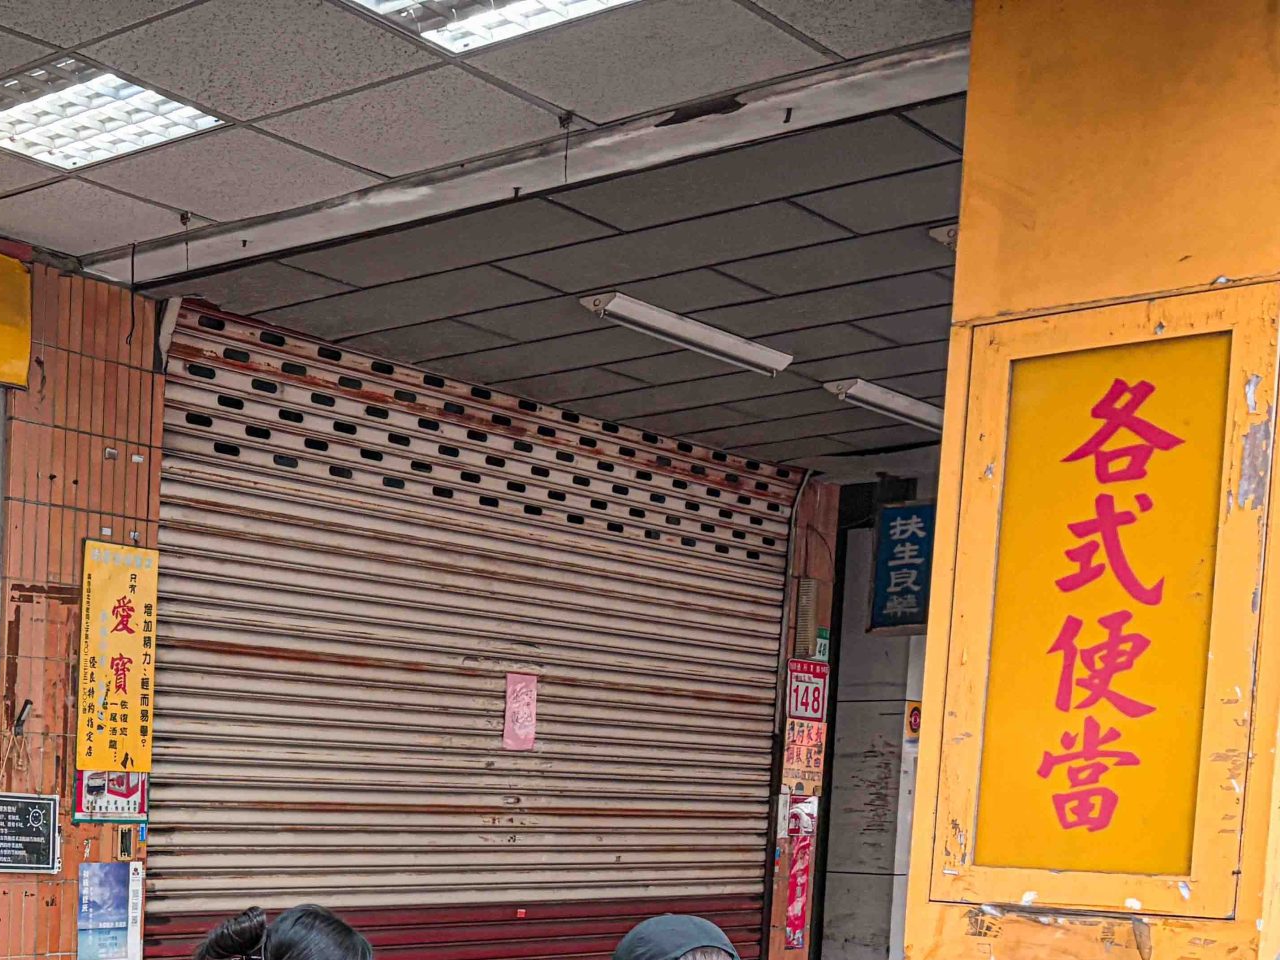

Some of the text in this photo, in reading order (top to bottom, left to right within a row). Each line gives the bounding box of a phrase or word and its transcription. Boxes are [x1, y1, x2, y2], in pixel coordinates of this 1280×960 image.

[792, 684, 822, 714] 148
[1036, 375, 1186, 833] 各式便當
